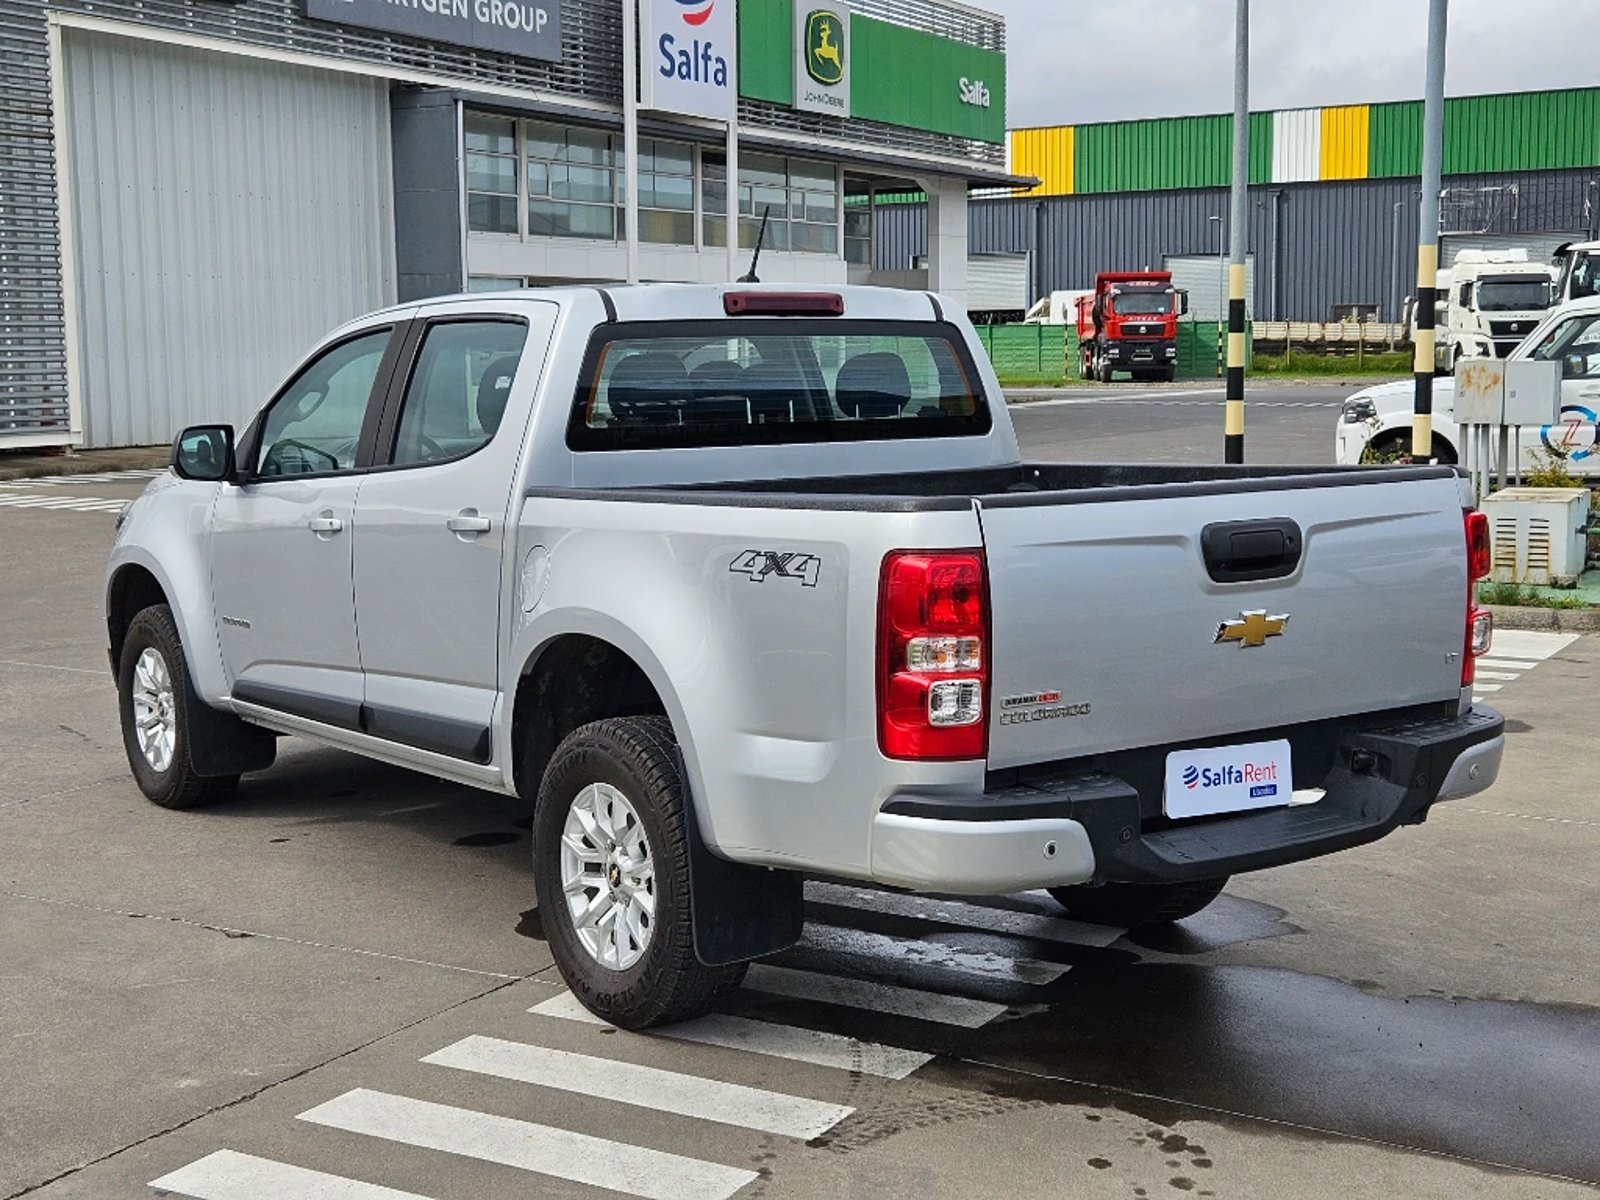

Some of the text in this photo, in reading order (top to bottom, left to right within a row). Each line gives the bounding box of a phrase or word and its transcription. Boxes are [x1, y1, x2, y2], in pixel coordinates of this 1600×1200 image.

[474, 0, 548, 33] GROUP
[659, 33, 727, 87] Salfa
[959, 77, 990, 107] Salfa
